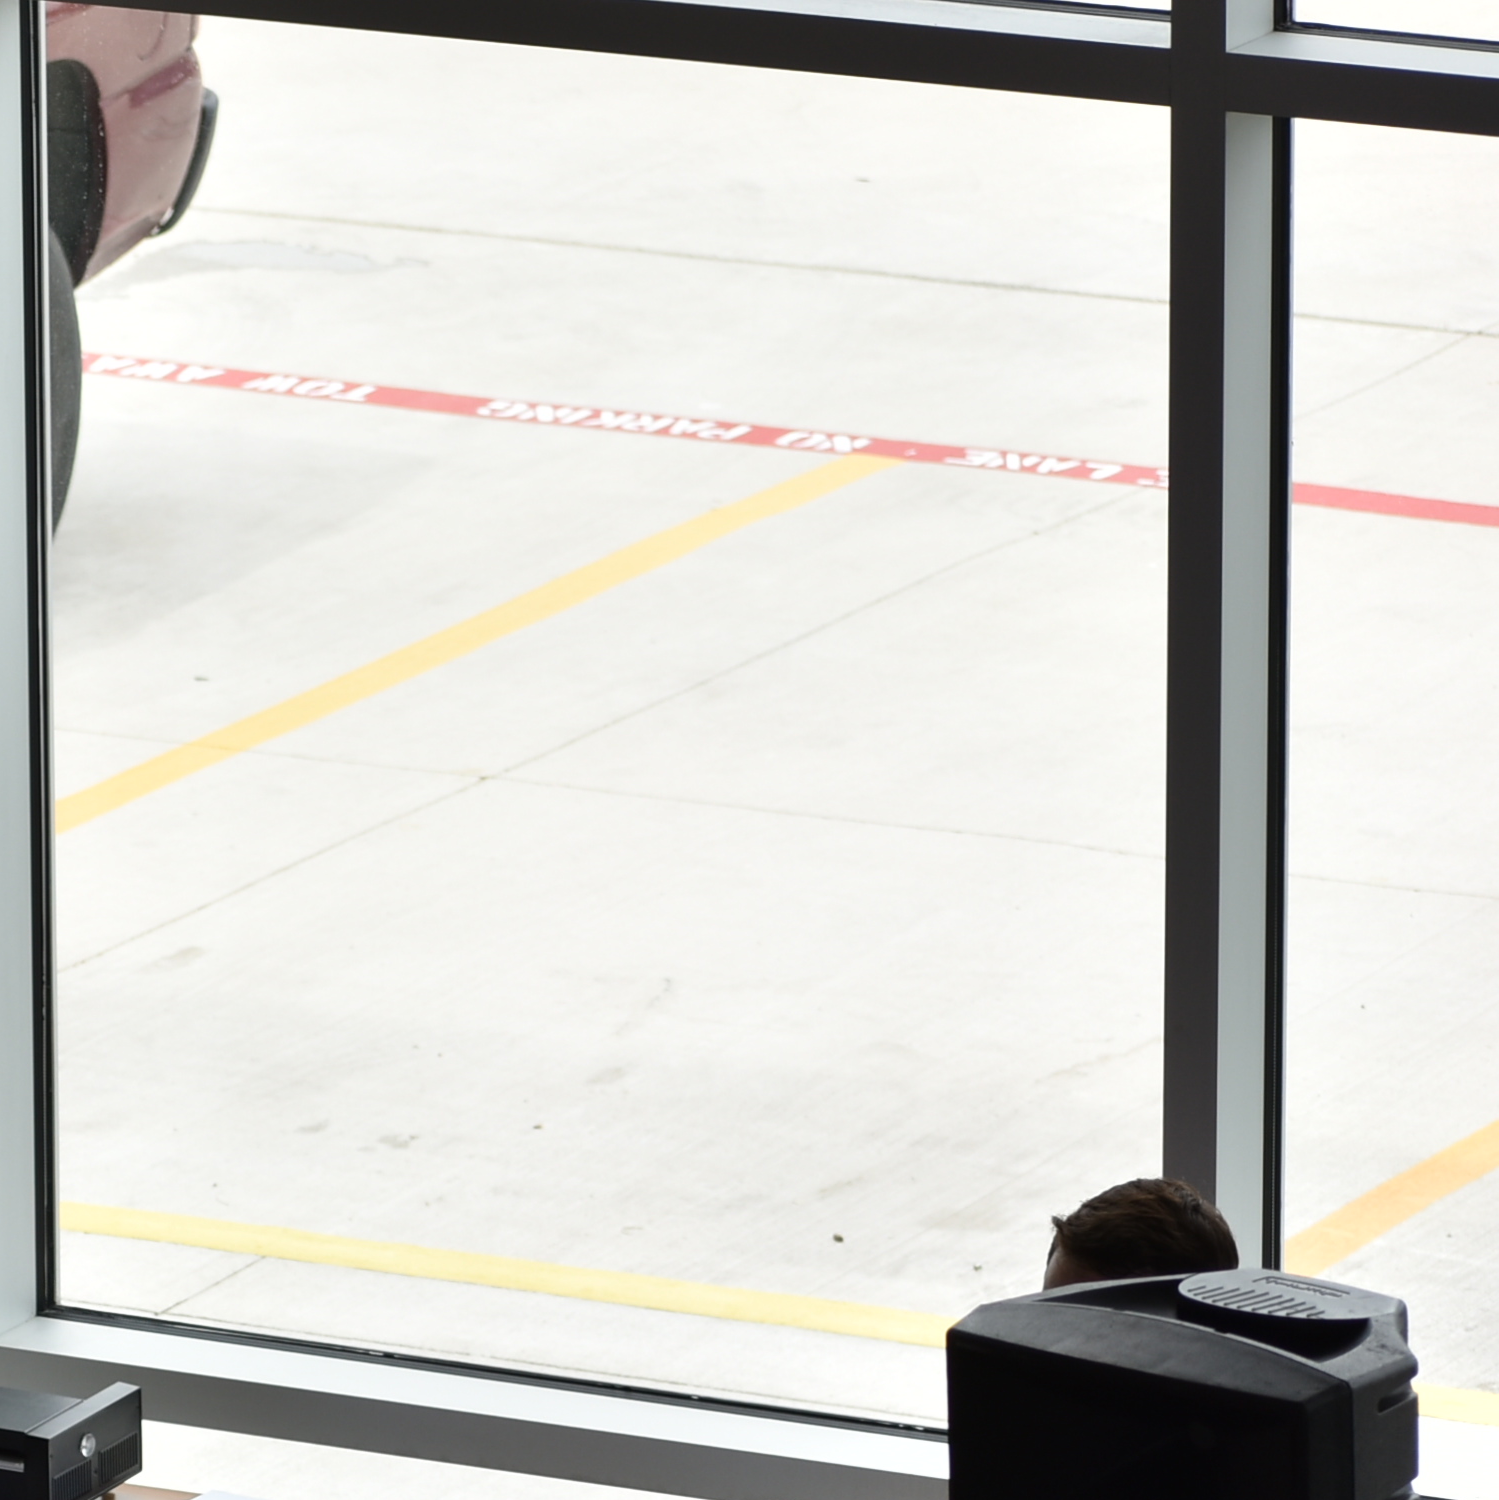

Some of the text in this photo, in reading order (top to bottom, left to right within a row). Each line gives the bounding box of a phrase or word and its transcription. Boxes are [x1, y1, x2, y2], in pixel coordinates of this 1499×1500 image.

[84, 354, 226, 382] AWA
[241, 374, 377, 402] TOW
[476, 399, 753, 440] PARKING
[774, 430, 872, 453] NO
[943, 449, 1124, 480] LANE
